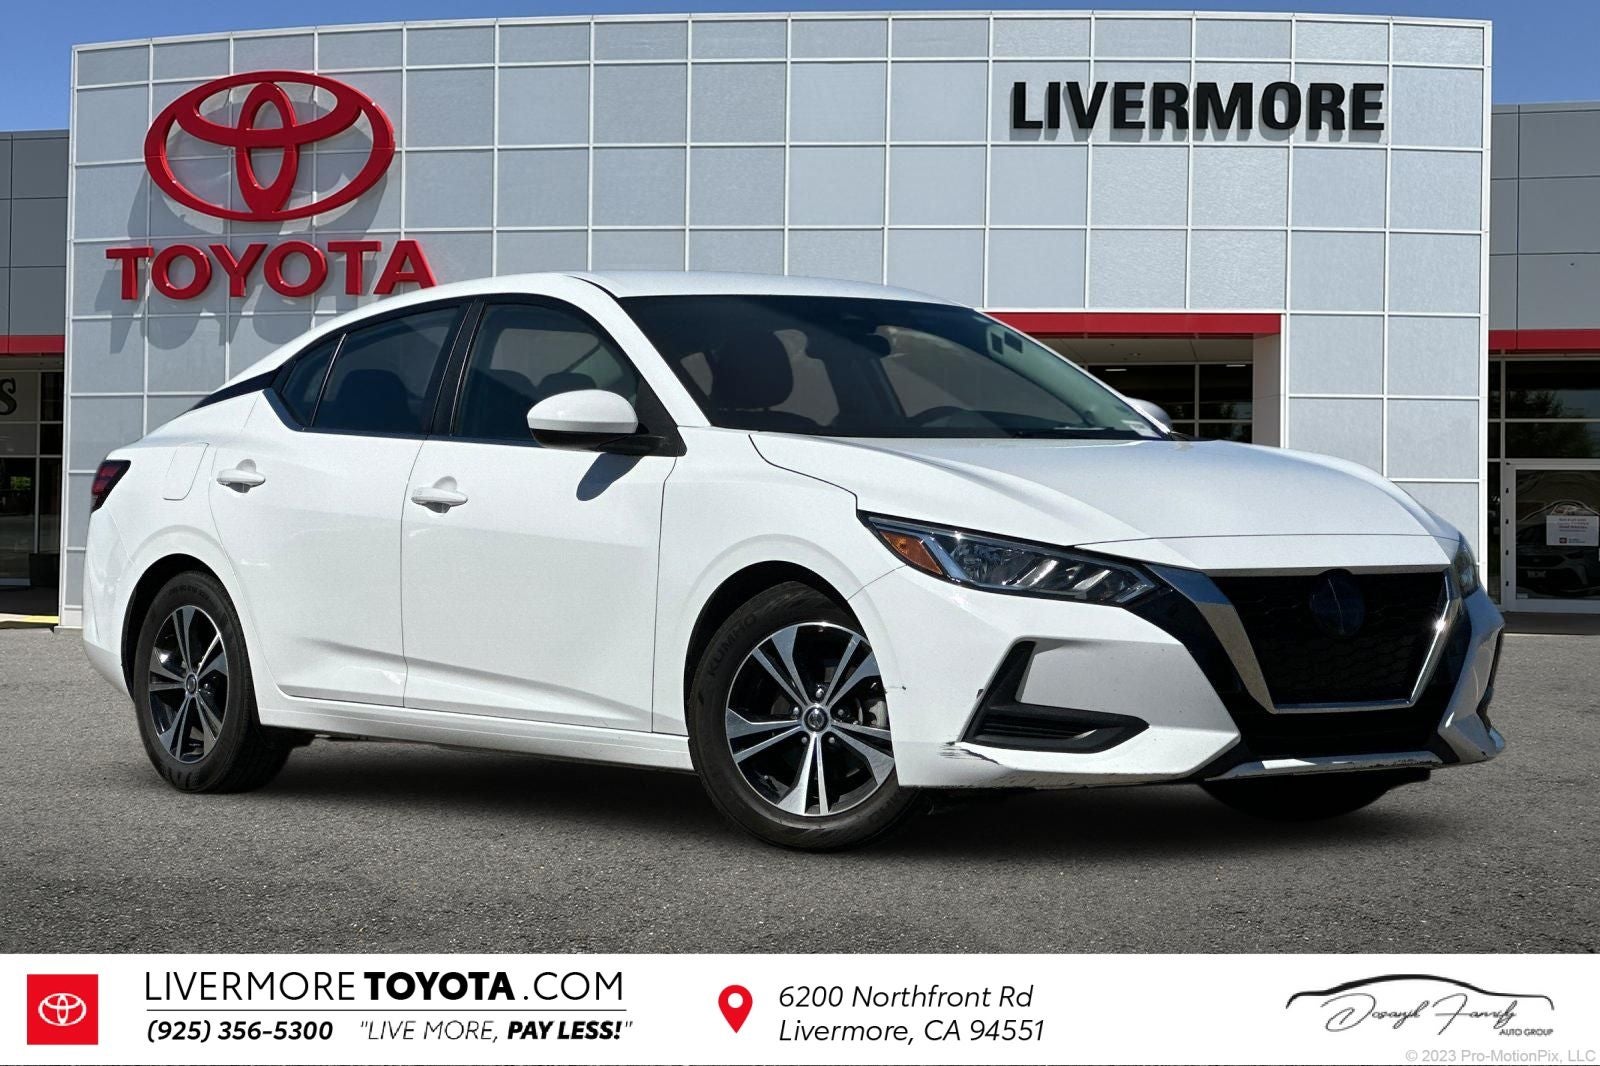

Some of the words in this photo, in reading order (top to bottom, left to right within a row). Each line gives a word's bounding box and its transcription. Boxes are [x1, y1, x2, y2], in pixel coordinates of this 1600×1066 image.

[1012, 81, 1386, 132] LIVERMORE
[105, 239, 438, 301] TOYOTA
[707, 612, 758, 677] KUMHO
